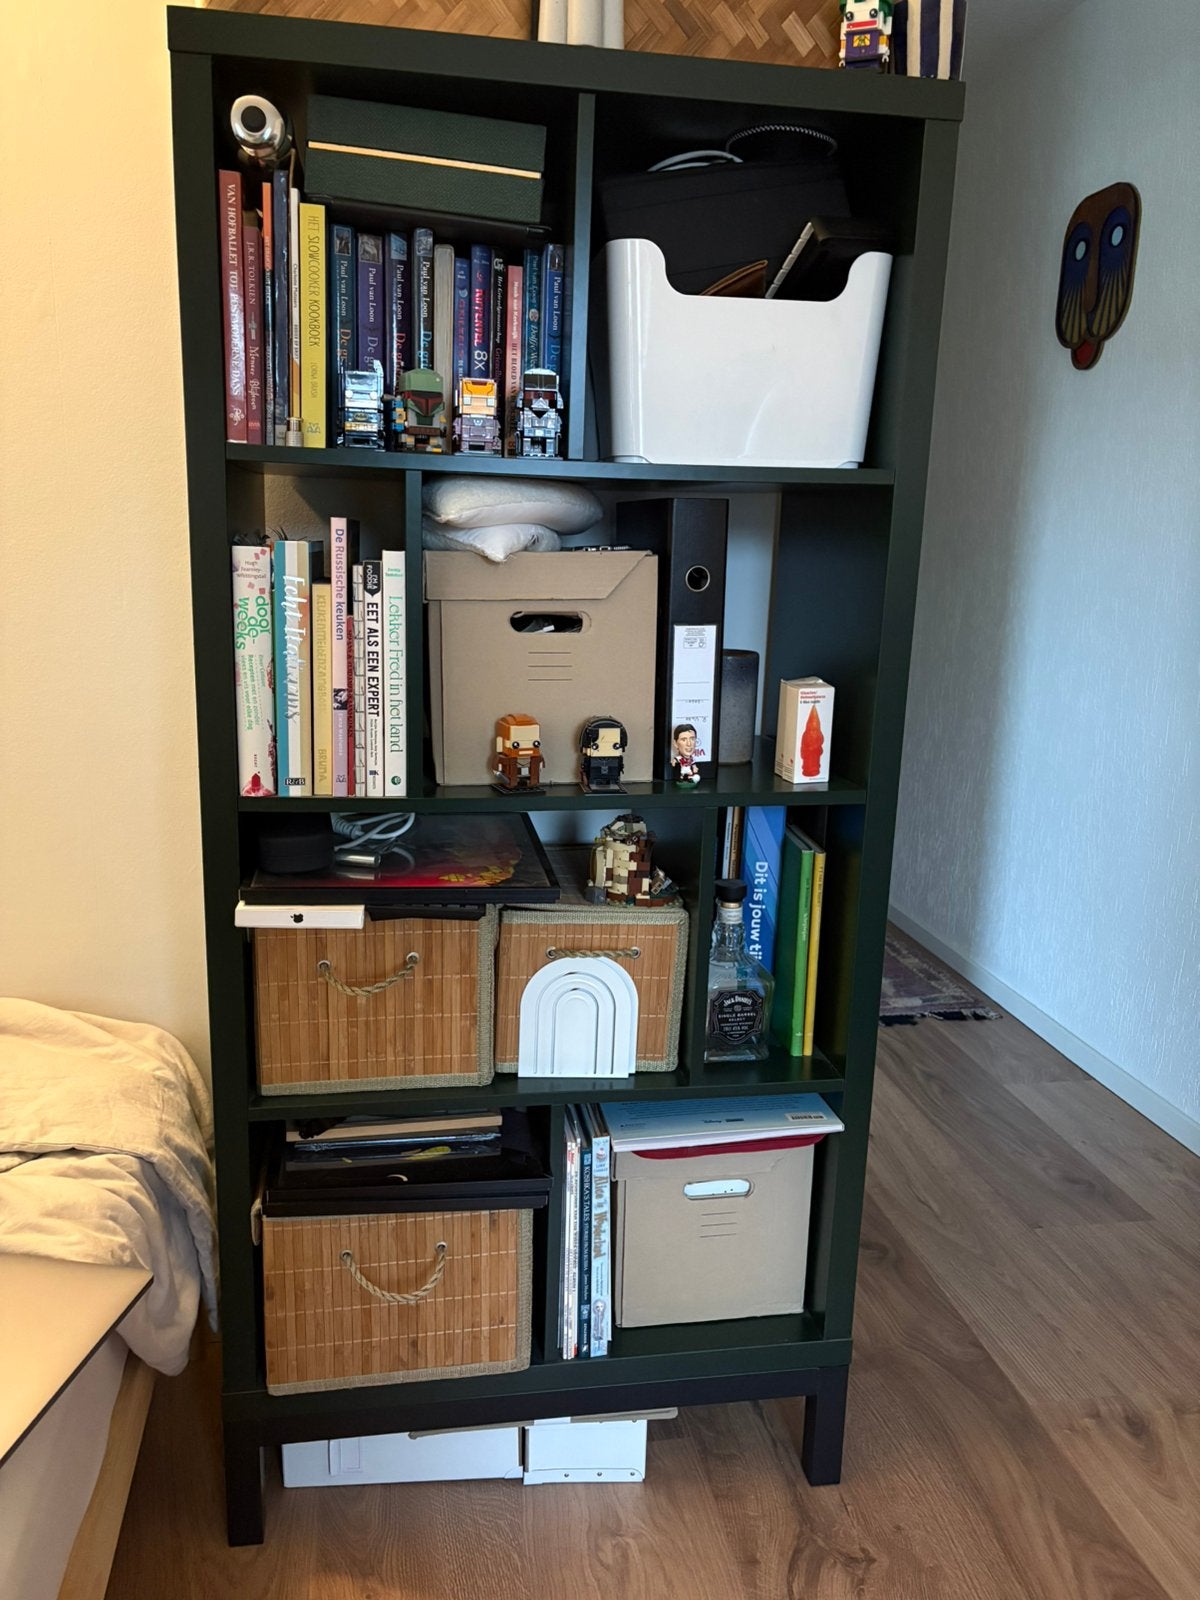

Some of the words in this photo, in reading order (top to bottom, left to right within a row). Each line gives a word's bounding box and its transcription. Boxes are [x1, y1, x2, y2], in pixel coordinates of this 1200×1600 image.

[226, 184, 236, 205] VAN
[308, 215, 319, 232] HET
[227, 206, 238, 266] HOFBALLET
[308, 235, 320, 296] SLOWCOOKER
[340, 260, 349, 279] Paul
[396, 264, 404, 282] Paul
[422, 261, 431, 279] Paul
[229, 270, 240, 291] TOT
[248, 266, 256, 305] TOLKIEN
[368, 267, 377, 286] Paul
[553, 276, 562, 294] Paul
[368, 287, 376, 301] van
[341, 296, 349, 317] Loon
[368, 302, 377, 323] Loon
[396, 299, 404, 320] Loon
[422, 297, 430, 318] Loon
[309, 299, 321, 348] KOOKBOEK
[552, 310, 561, 331] Loon
[340, 328, 352, 344] De
[367, 336, 378, 353] De
[395, 332, 406, 346] De
[422, 330, 432, 347] De
[529, 324, 539, 351] Dolfje
[248, 346, 260, 376] Meneer
[550, 344, 561, 360] De
[335, 528, 345, 543] De
[335, 545, 345, 599] Russische
[280, 575, 308, 621] Echt
[235, 596, 250, 650] weeks
[254, 595, 270, 635] door
[335, 601, 346, 641] keuken
[366, 602, 379, 624] EET
[388, 595, 403, 646] Lekker
[247, 623, 260, 644] de-
[367, 627, 379, 648] ALS
[247, 654, 255, 683] Recepten
[367, 650, 379, 673] EEN
[367, 676, 380, 718] EXPERT
[389, 683, 403, 696] in
[389, 699, 404, 720] het
[246, 718, 254, 731] dag
[390, 723, 404, 753] land
[317, 748, 328, 783] BRUNA
[754, 861, 769, 886] Dit
[752, 887, 768, 901] is
[748, 902, 766, 942] jouw
[583, 1166, 592, 1200] KOSHKA'S
[593, 1176, 609, 1199] Alice
[583, 1200, 591, 1222] TALES
